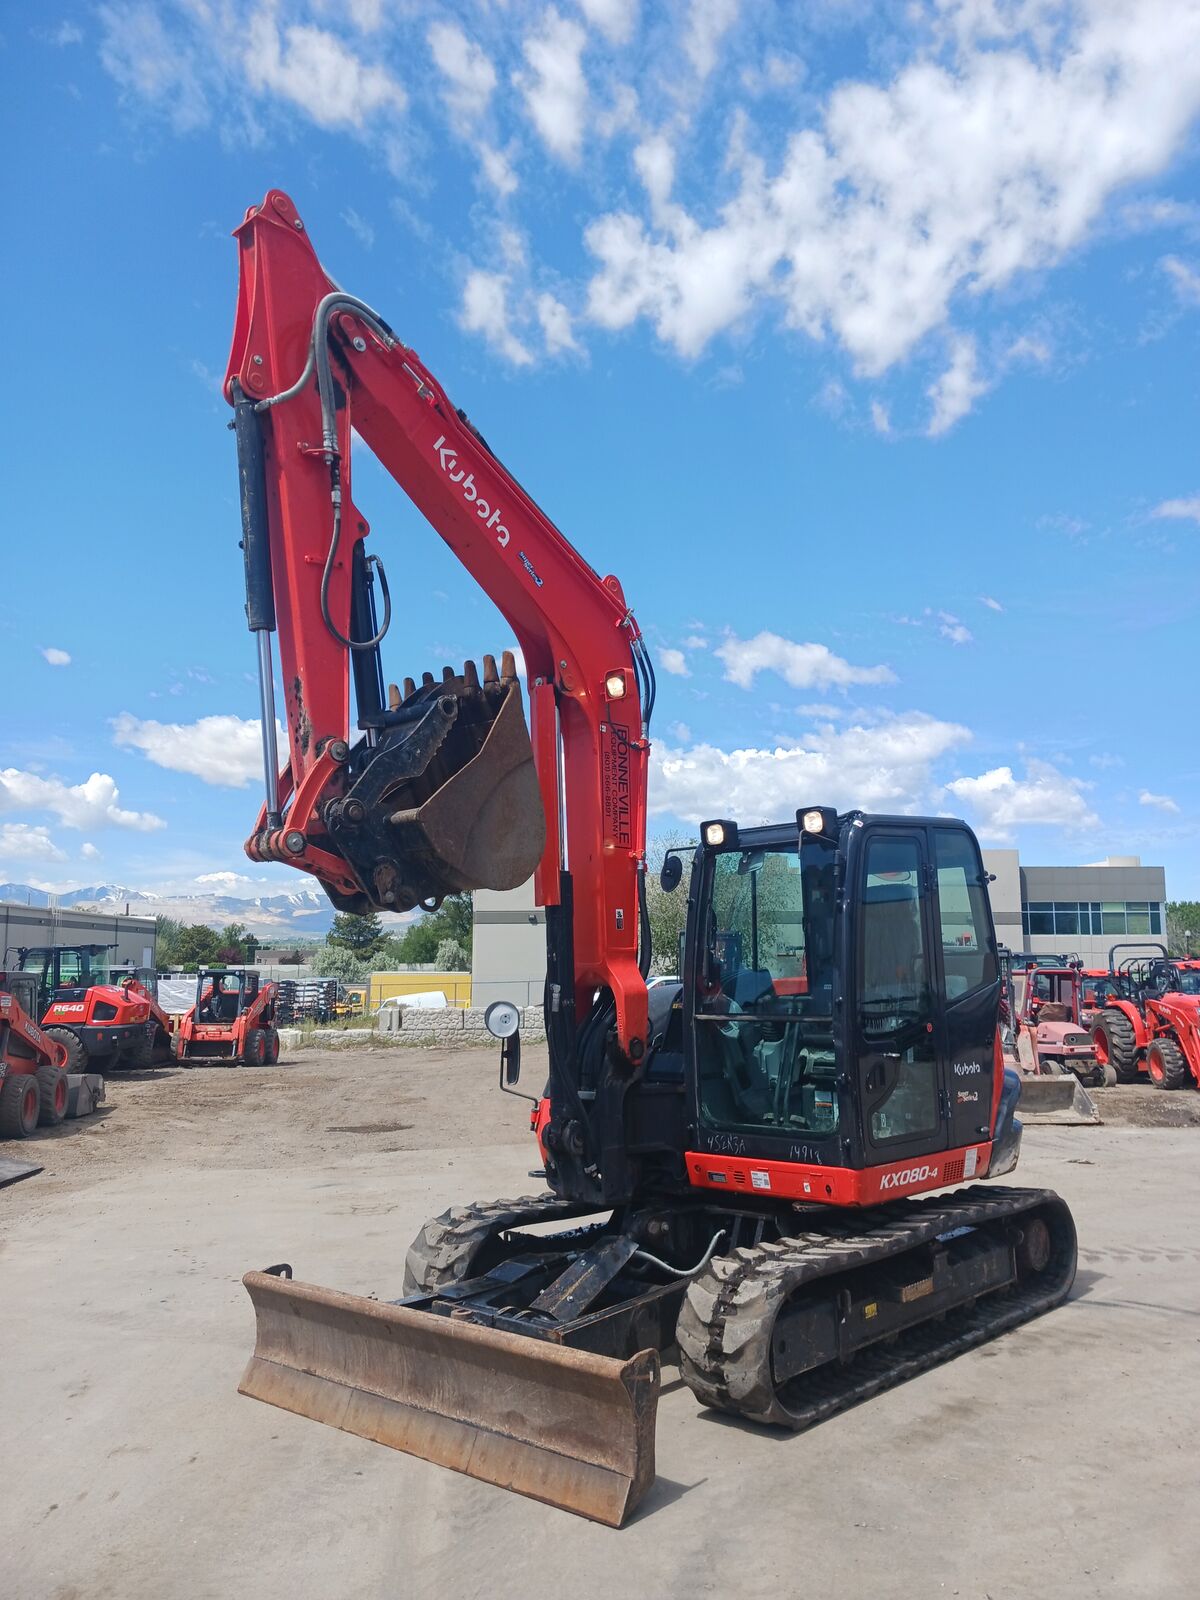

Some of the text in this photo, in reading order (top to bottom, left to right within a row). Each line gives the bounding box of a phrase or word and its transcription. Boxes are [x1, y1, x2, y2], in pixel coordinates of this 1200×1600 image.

[433, 435, 510, 548] Kubota
[617, 729, 630, 844] BONNEVILLE
[53, 1004, 84, 1012] R640
[24, 1021, 41, 1043] KUBOTA
[954, 1061, 981, 1076] Kubota
[879, 1165, 938, 1190] KX080-4
